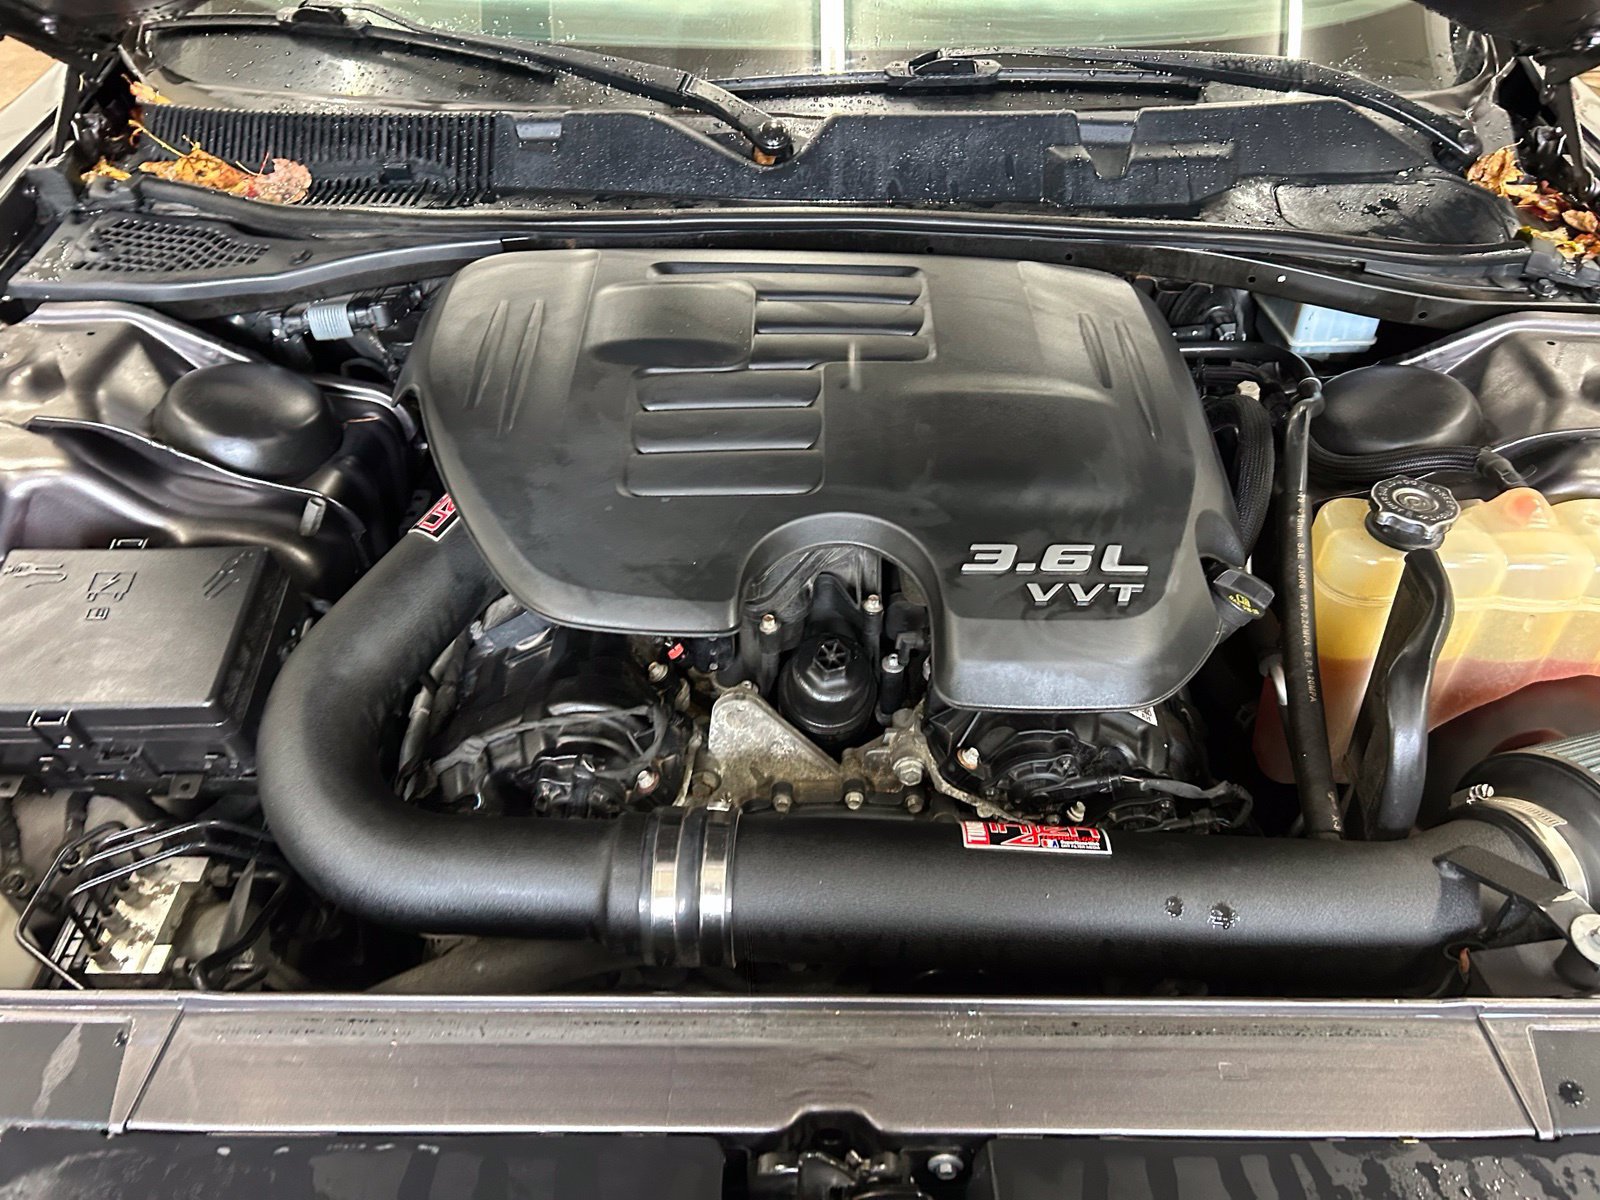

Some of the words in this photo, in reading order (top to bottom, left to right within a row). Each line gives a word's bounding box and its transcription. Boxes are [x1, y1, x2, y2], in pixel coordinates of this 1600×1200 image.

[961, 543, 1149, 575] 3.6L
[1297, 542, 1305, 560] SAE
[1026, 583, 1145, 606] VVT
